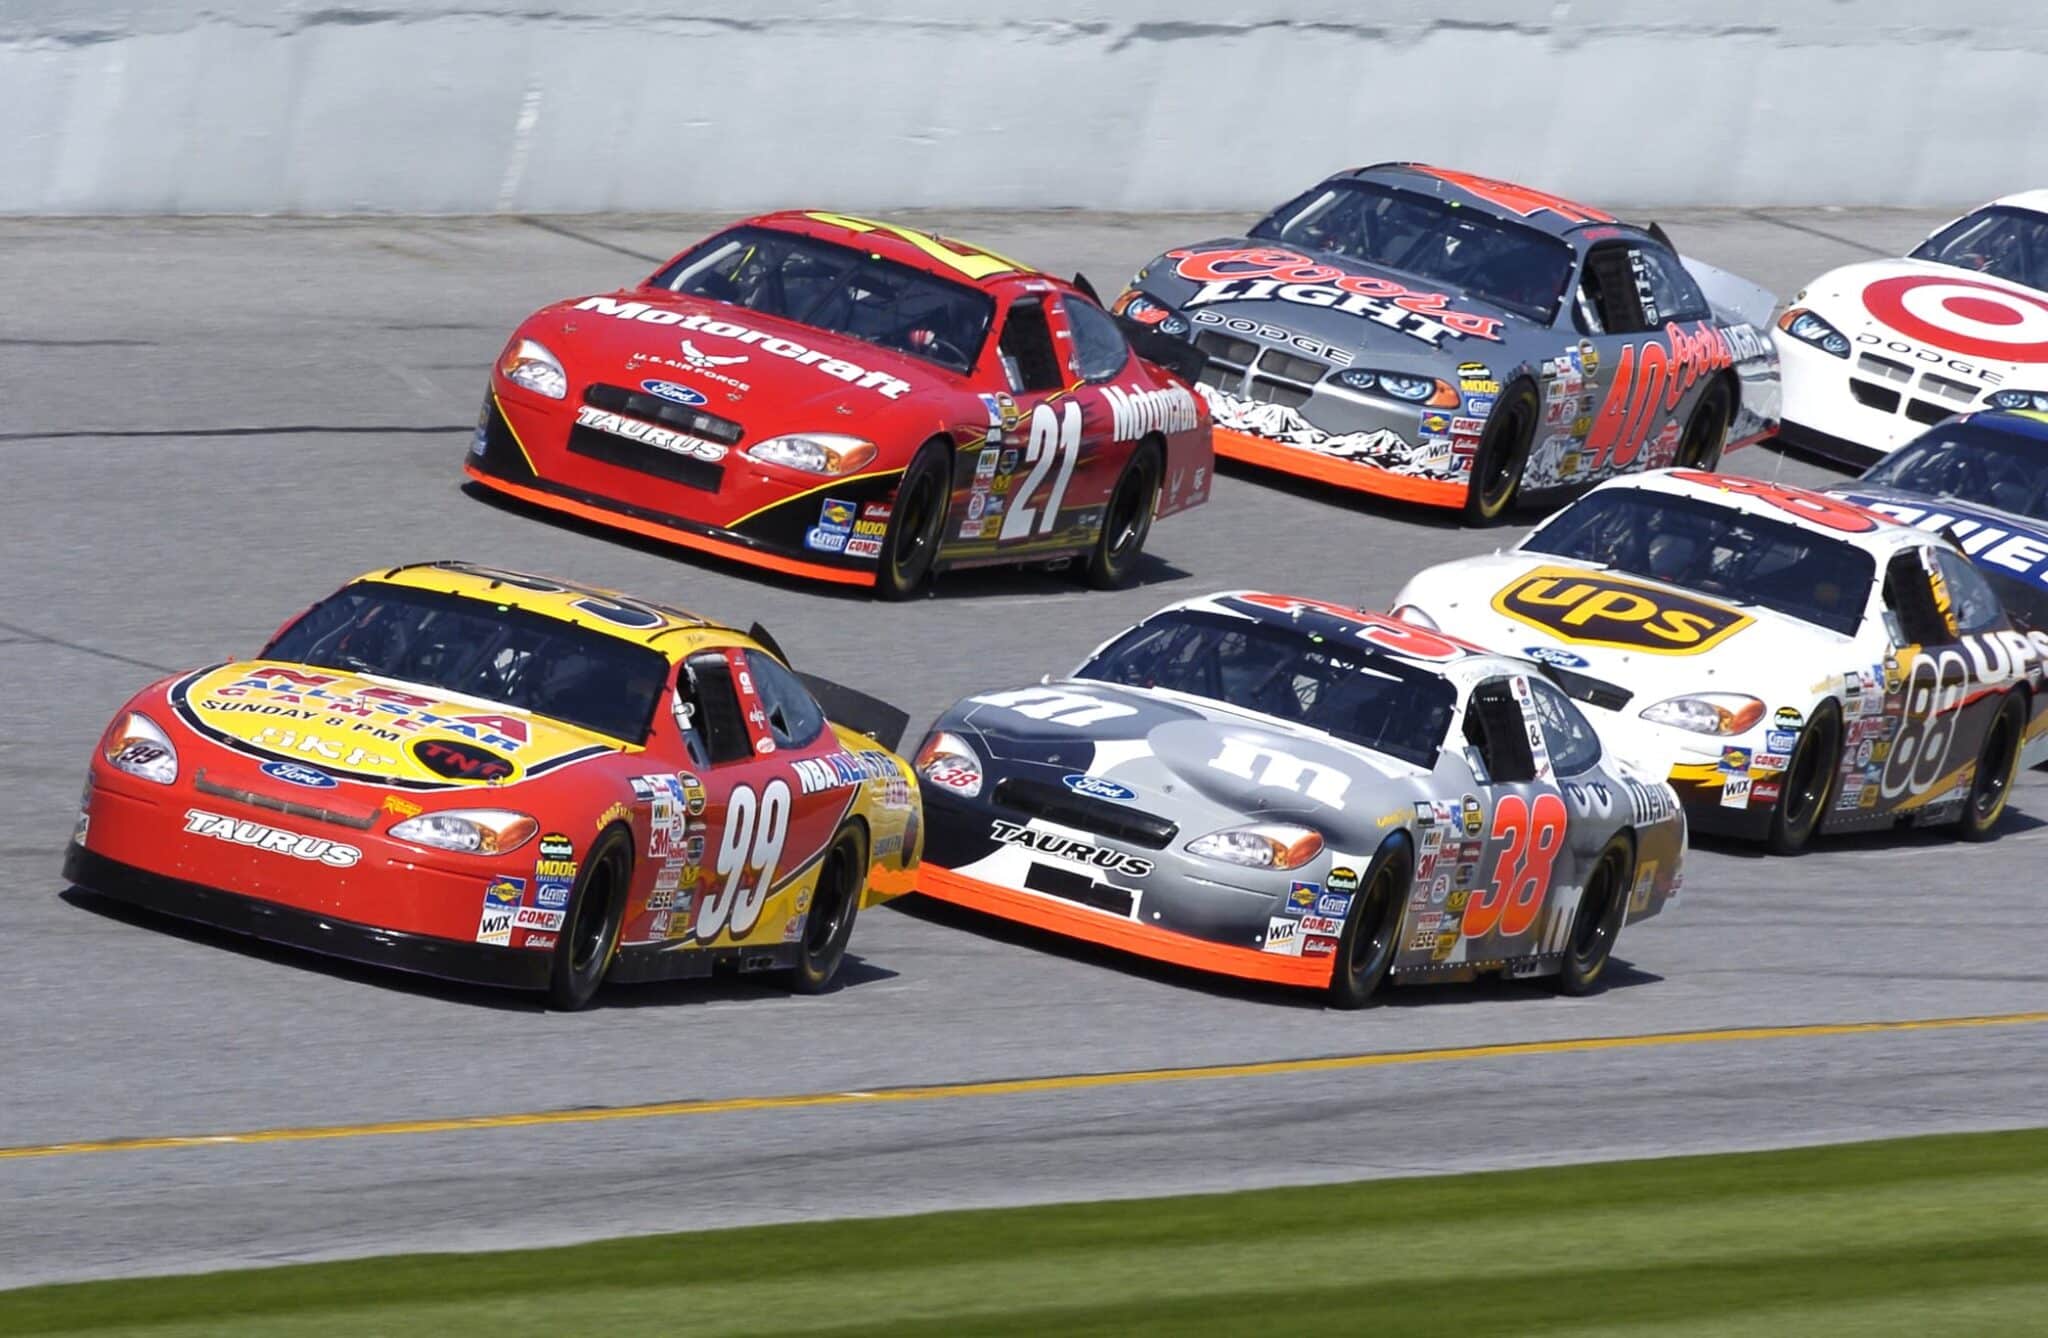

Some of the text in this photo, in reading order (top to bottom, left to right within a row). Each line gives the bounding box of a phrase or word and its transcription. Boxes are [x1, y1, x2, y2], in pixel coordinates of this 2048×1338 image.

[1165, 247, 1505, 342] Coors
[1180, 279, 1464, 346] LIGHT
[573, 296, 912, 400] Motorcraft
[1191, 309, 1357, 367] DODGE
[1856, 333, 2004, 386] DODGE
[633, 352, 750, 391] U.S. AIR FORCE
[650, 381, 697, 402] Ford
[1461, 379, 1500, 393] MOOG
[1666, 320, 1733, 412] Coors
[1582, 341, 1668, 470] 40
[576, 404, 729, 462] TAURUS
[1000, 399, 1083, 540] 21
[1516, 578, 1716, 643] ups
[1532, 647, 1578, 667] Ford
[201, 699, 402, 742] SUNDAY 8 PM
[247, 668, 531, 743] NBA
[1881, 651, 1969, 798] 88
[120, 745, 164, 764] 99
[271, 762, 324, 786] Ford
[791, 758, 839, 794] NBA
[934, 767, 979, 788] 38
[1207, 737, 1353, 811] m
[1076, 776, 1127, 799] Ford
[1726, 781, 1749, 797] WIX
[184, 809, 364, 867] TAURUS
[697, 779, 791, 938] 99
[991, 820, 1153, 877] TAURUS
[536, 860, 578, 877] MOOG
[1461, 793, 1568, 938] 38
[483, 914, 511, 933] WIX
[518, 910, 554, 925] COMP
[1270, 922, 1296, 940] WIX
[1302, 917, 1332, 929] COMP
